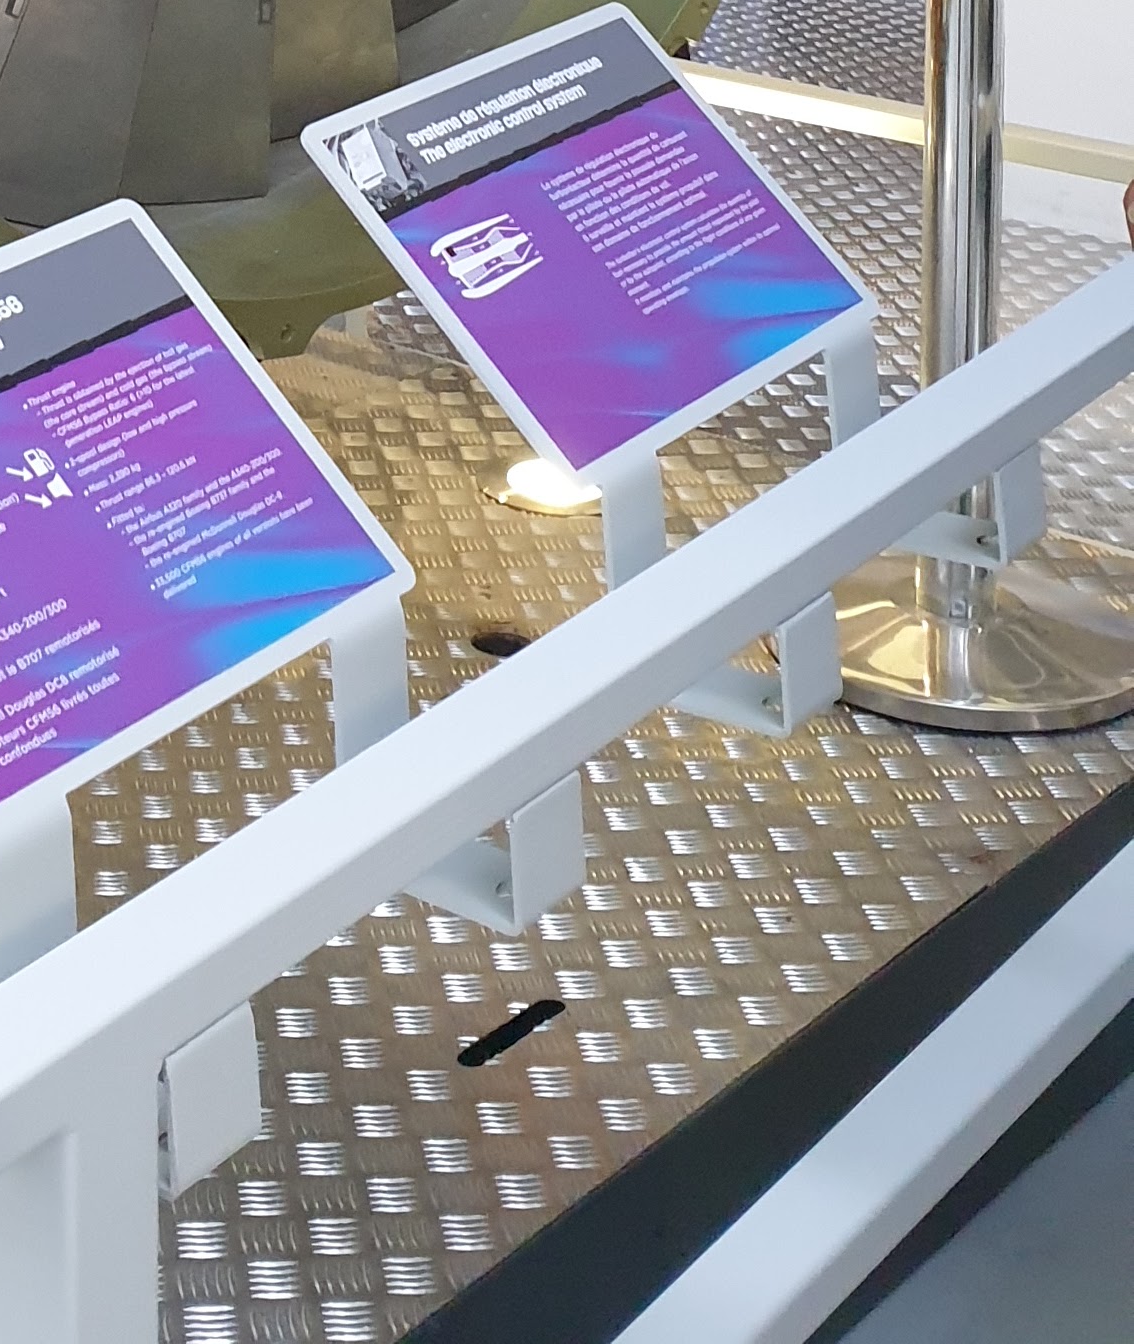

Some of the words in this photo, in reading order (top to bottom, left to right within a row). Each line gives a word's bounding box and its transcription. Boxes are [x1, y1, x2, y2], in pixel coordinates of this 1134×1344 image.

[406, 115, 463, 147] Système
[458, 108, 479, 125] de
[474, 84, 537, 119] régulation
[532, 56, 603, 94] électronique
[418, 144, 447, 165] The
[443, 119, 506, 154] electronic
[502, 99, 547, 129] control
[542, 84, 587, 111] system
[3, 687, 47, 716] Douglas
[68, 645, 120, 681] remotorisé
[4, 664, 17, 676] le
[15, 647, 42, 670] B707
[44, 619, 101, 655] remotorisés
[25, 703, 62, 730] CFM56
[59, 689, 89, 710] livrés
[87, 672, 120, 695] toutes
